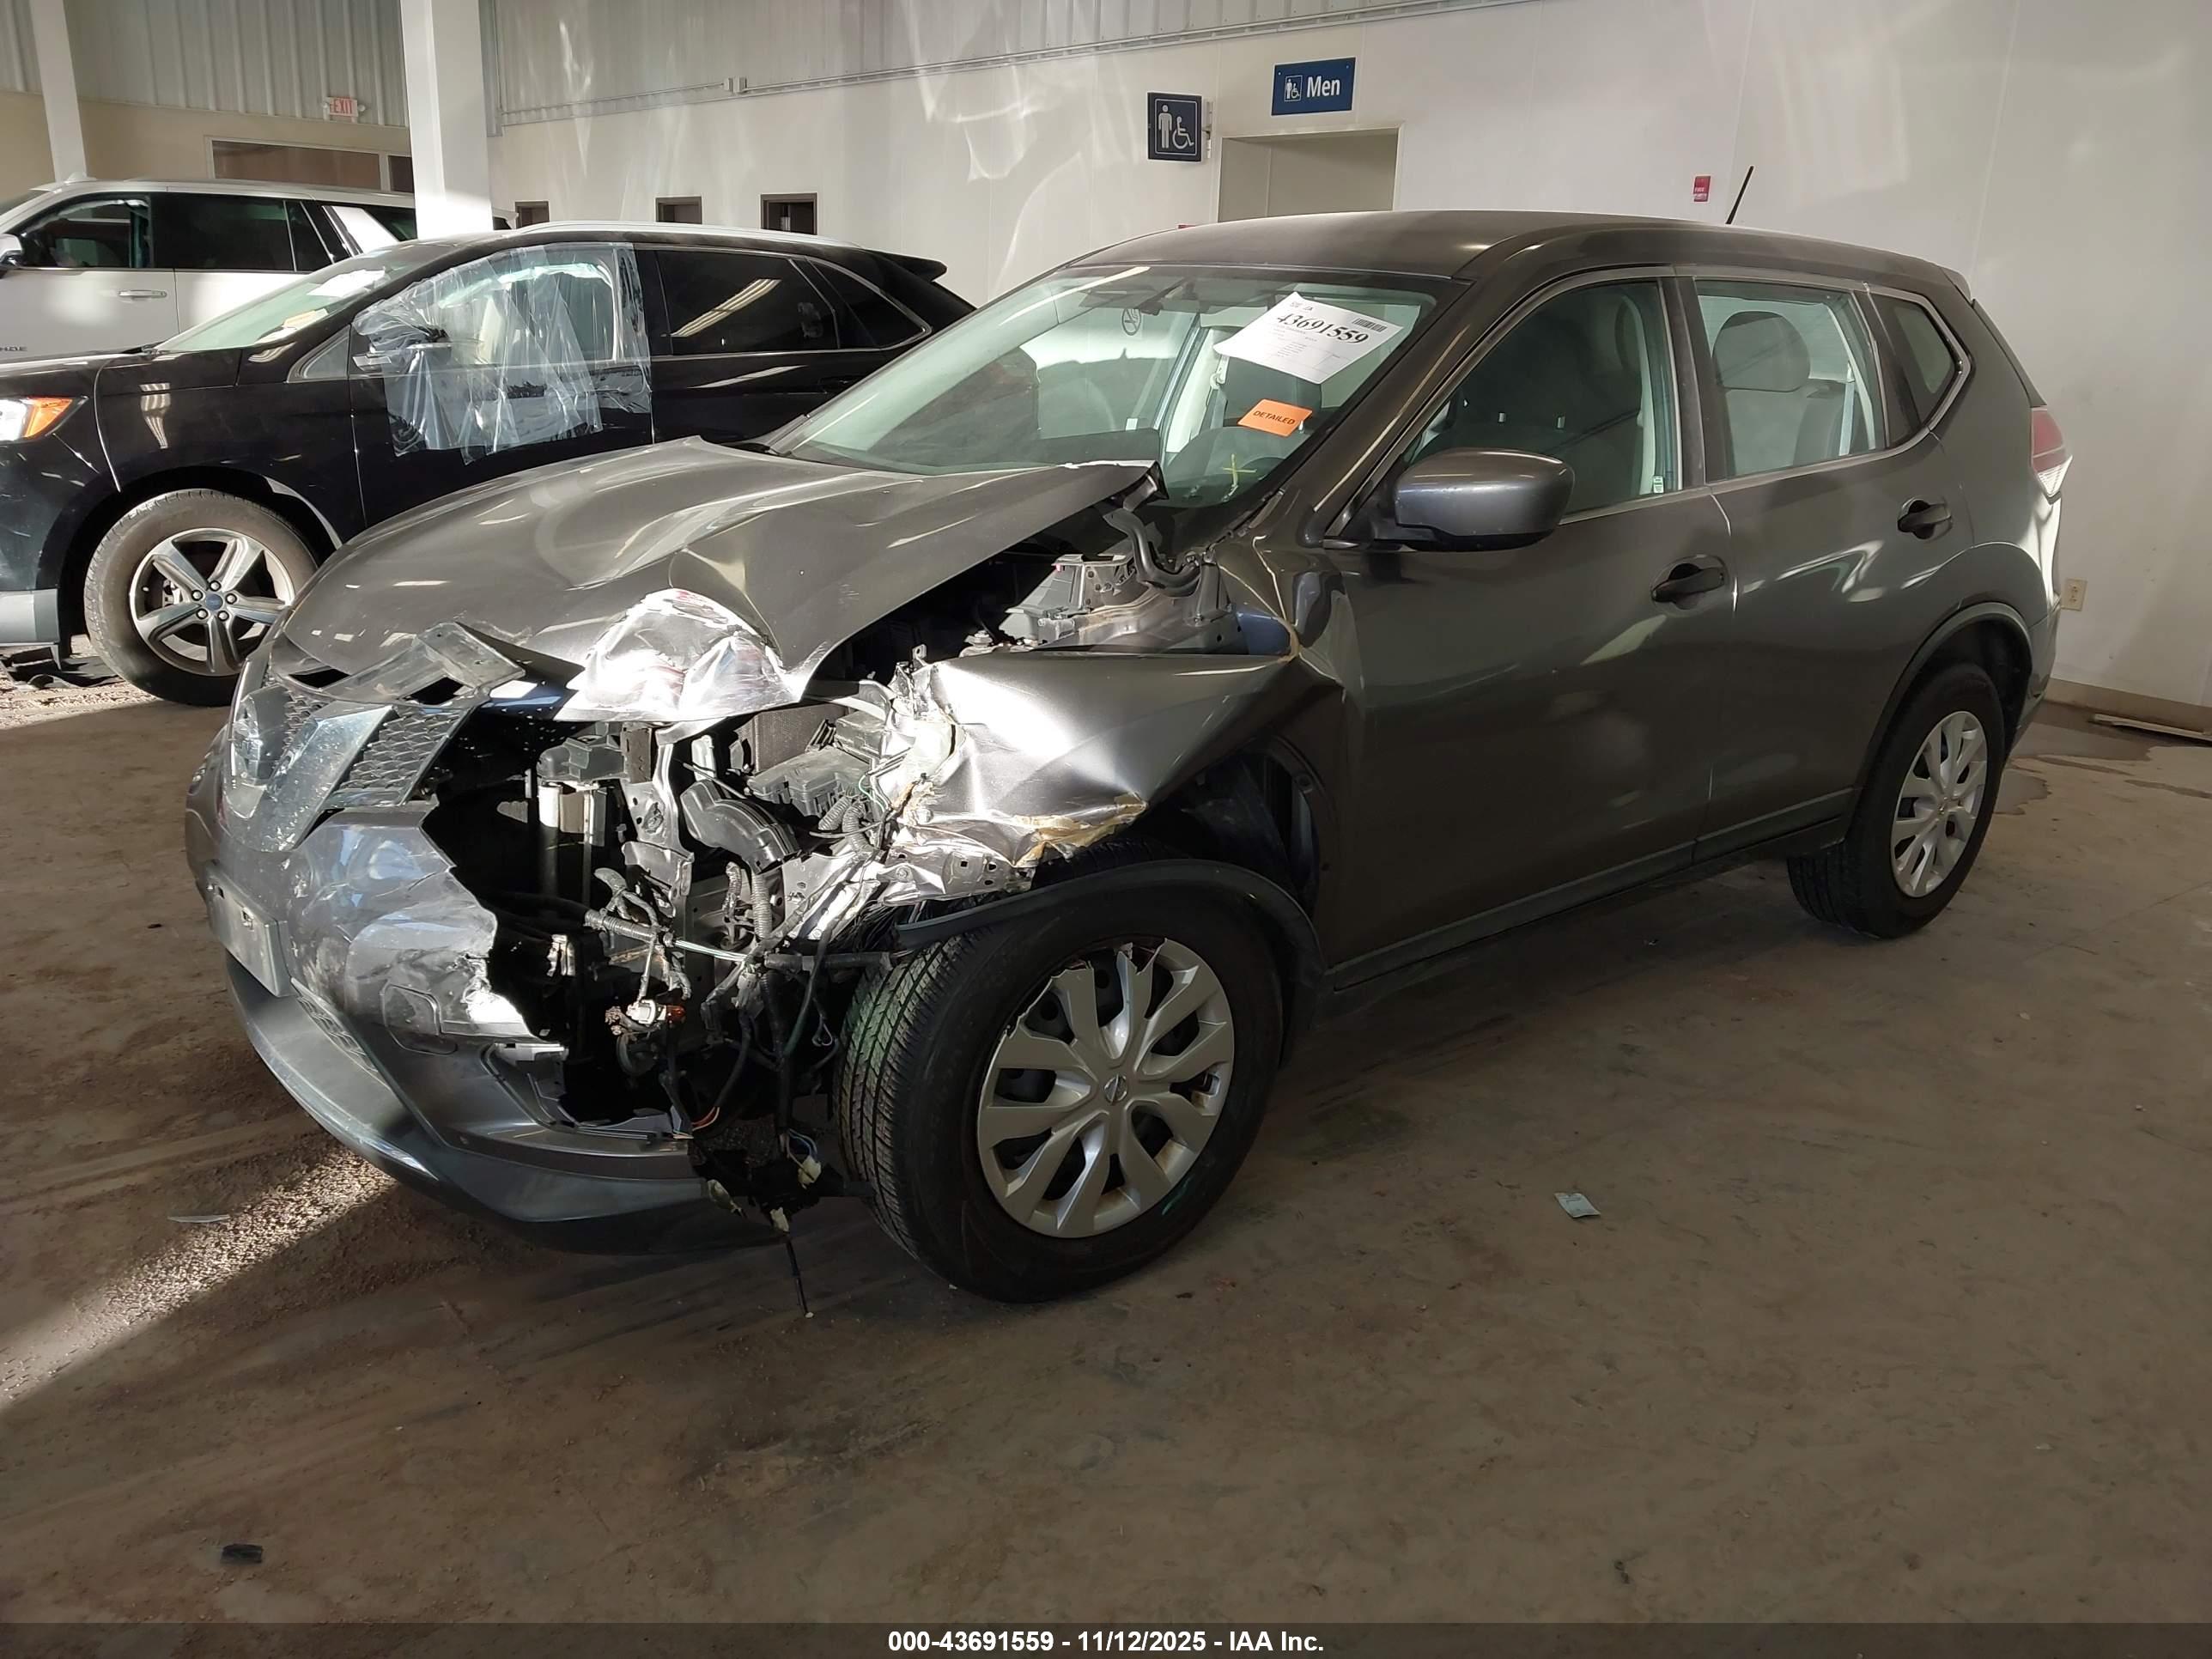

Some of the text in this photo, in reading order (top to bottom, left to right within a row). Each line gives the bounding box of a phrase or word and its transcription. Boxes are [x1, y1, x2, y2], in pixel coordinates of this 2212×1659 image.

[1306, 76, 1340, 98] Men
[333, 97, 352, 114] EXIT
[1277, 313, 1370, 343] 43691559
[1253, 410, 1296, 425] DETAILED
